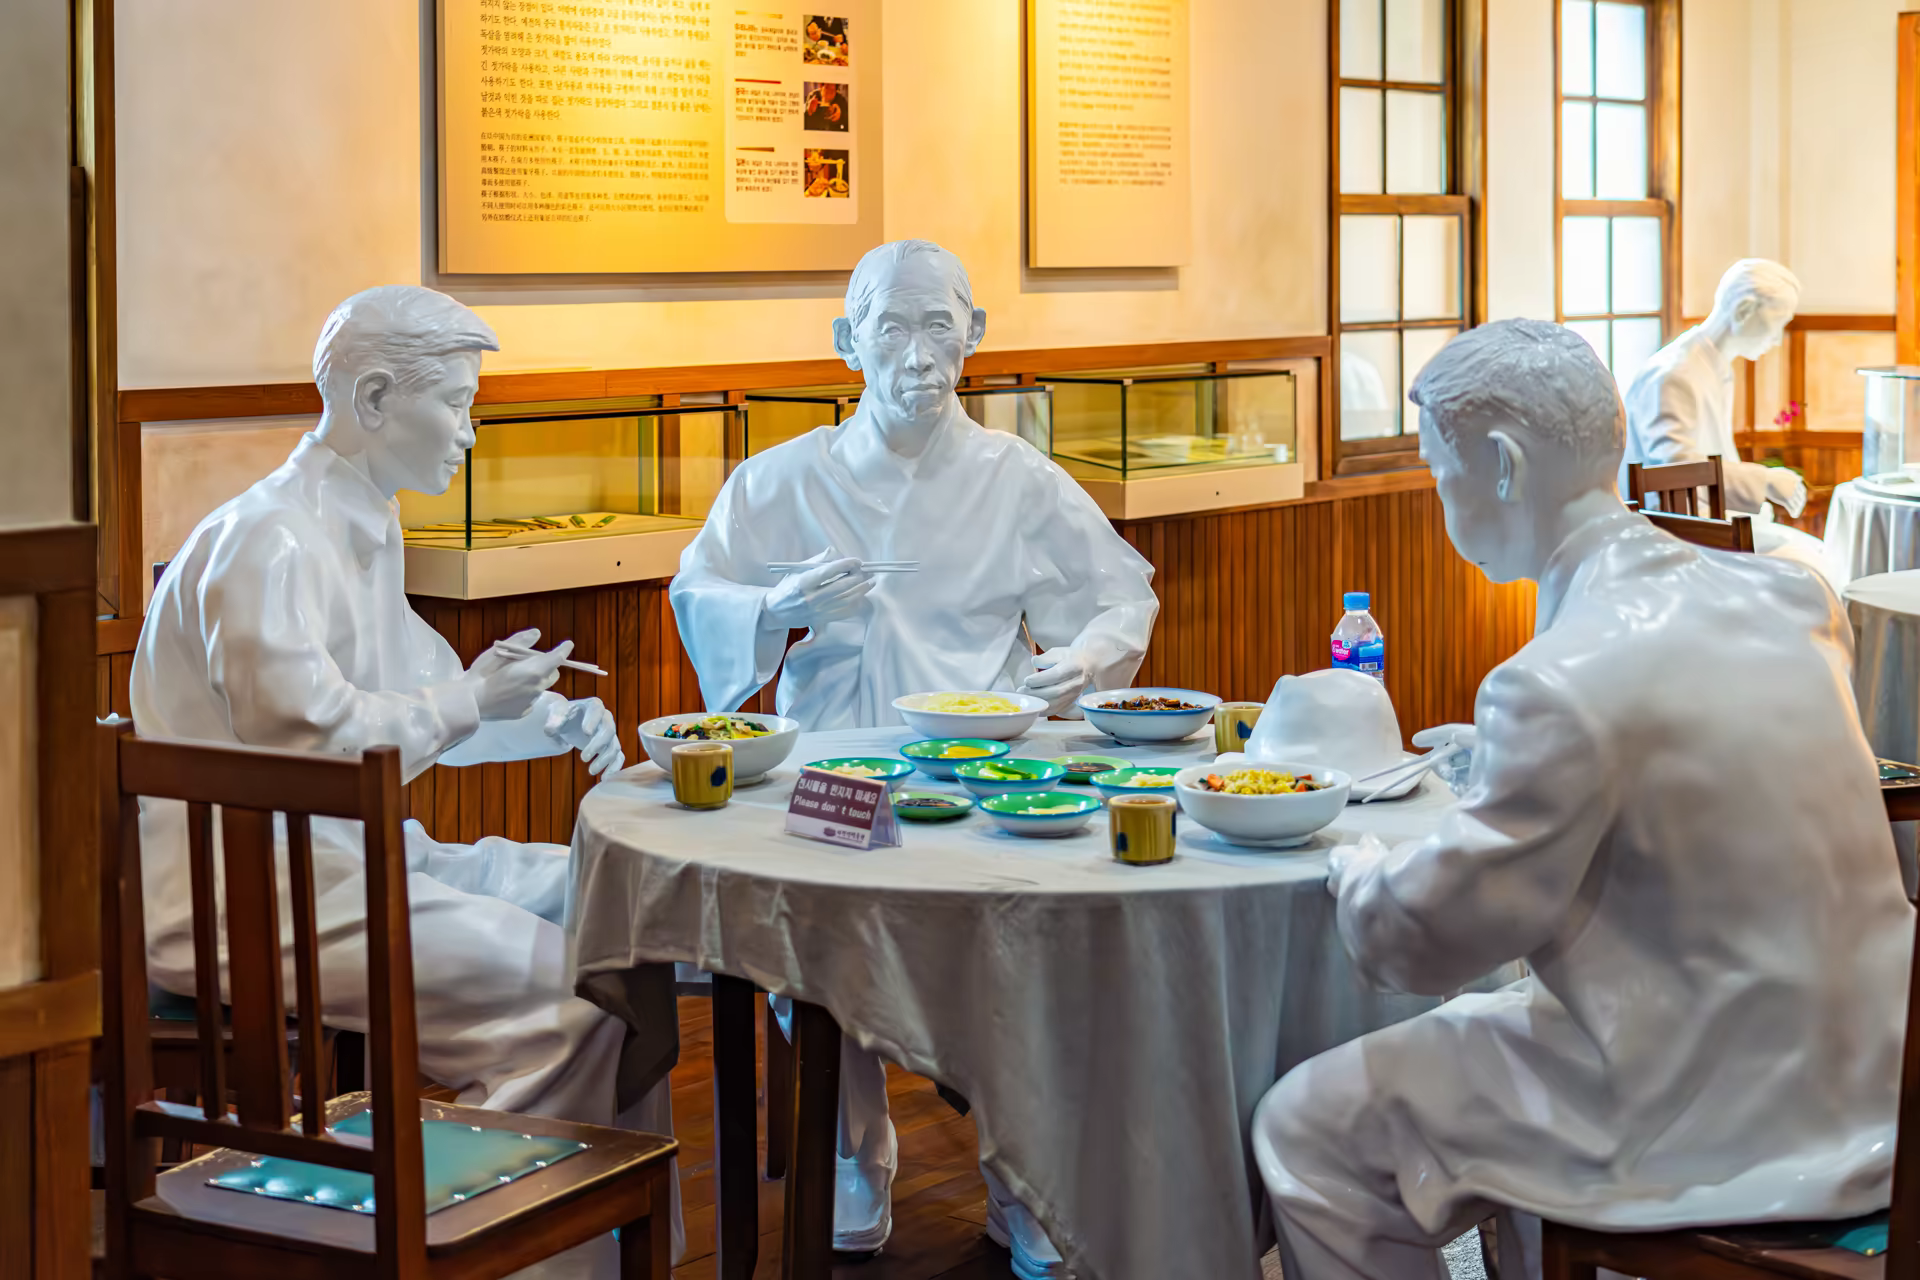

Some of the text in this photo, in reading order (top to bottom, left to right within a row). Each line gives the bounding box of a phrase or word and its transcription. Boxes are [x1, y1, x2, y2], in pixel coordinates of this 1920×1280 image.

[481, 76, 516, 87] 사용하기도
[504, 109, 531, 119] 젓가락을
[830, 784, 854, 800] 만지지
[855, 789, 878, 804] 마세요
[793, 795, 819, 809] Please
[849, 807, 872, 820] touch
